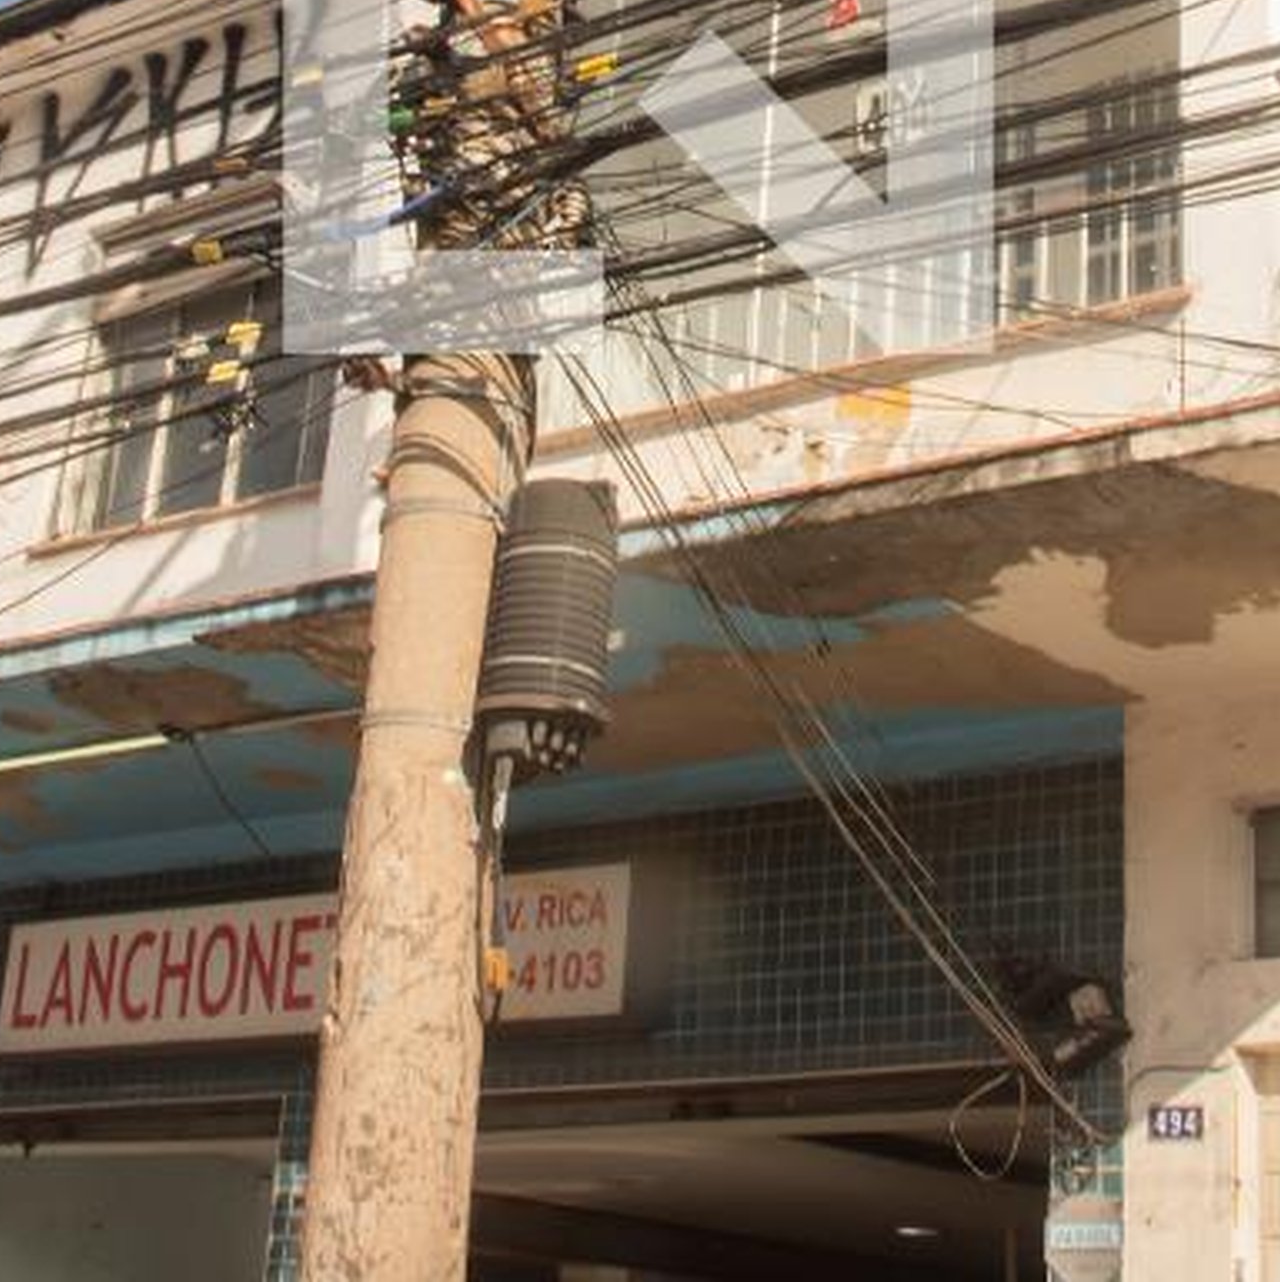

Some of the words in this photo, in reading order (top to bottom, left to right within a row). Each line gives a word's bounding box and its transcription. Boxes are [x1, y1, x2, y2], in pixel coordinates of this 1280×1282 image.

[537, 889, 609, 930] RICA
[488, 949, 606, 995] -4103
[1153, 1110, 1197, 1137] 494
